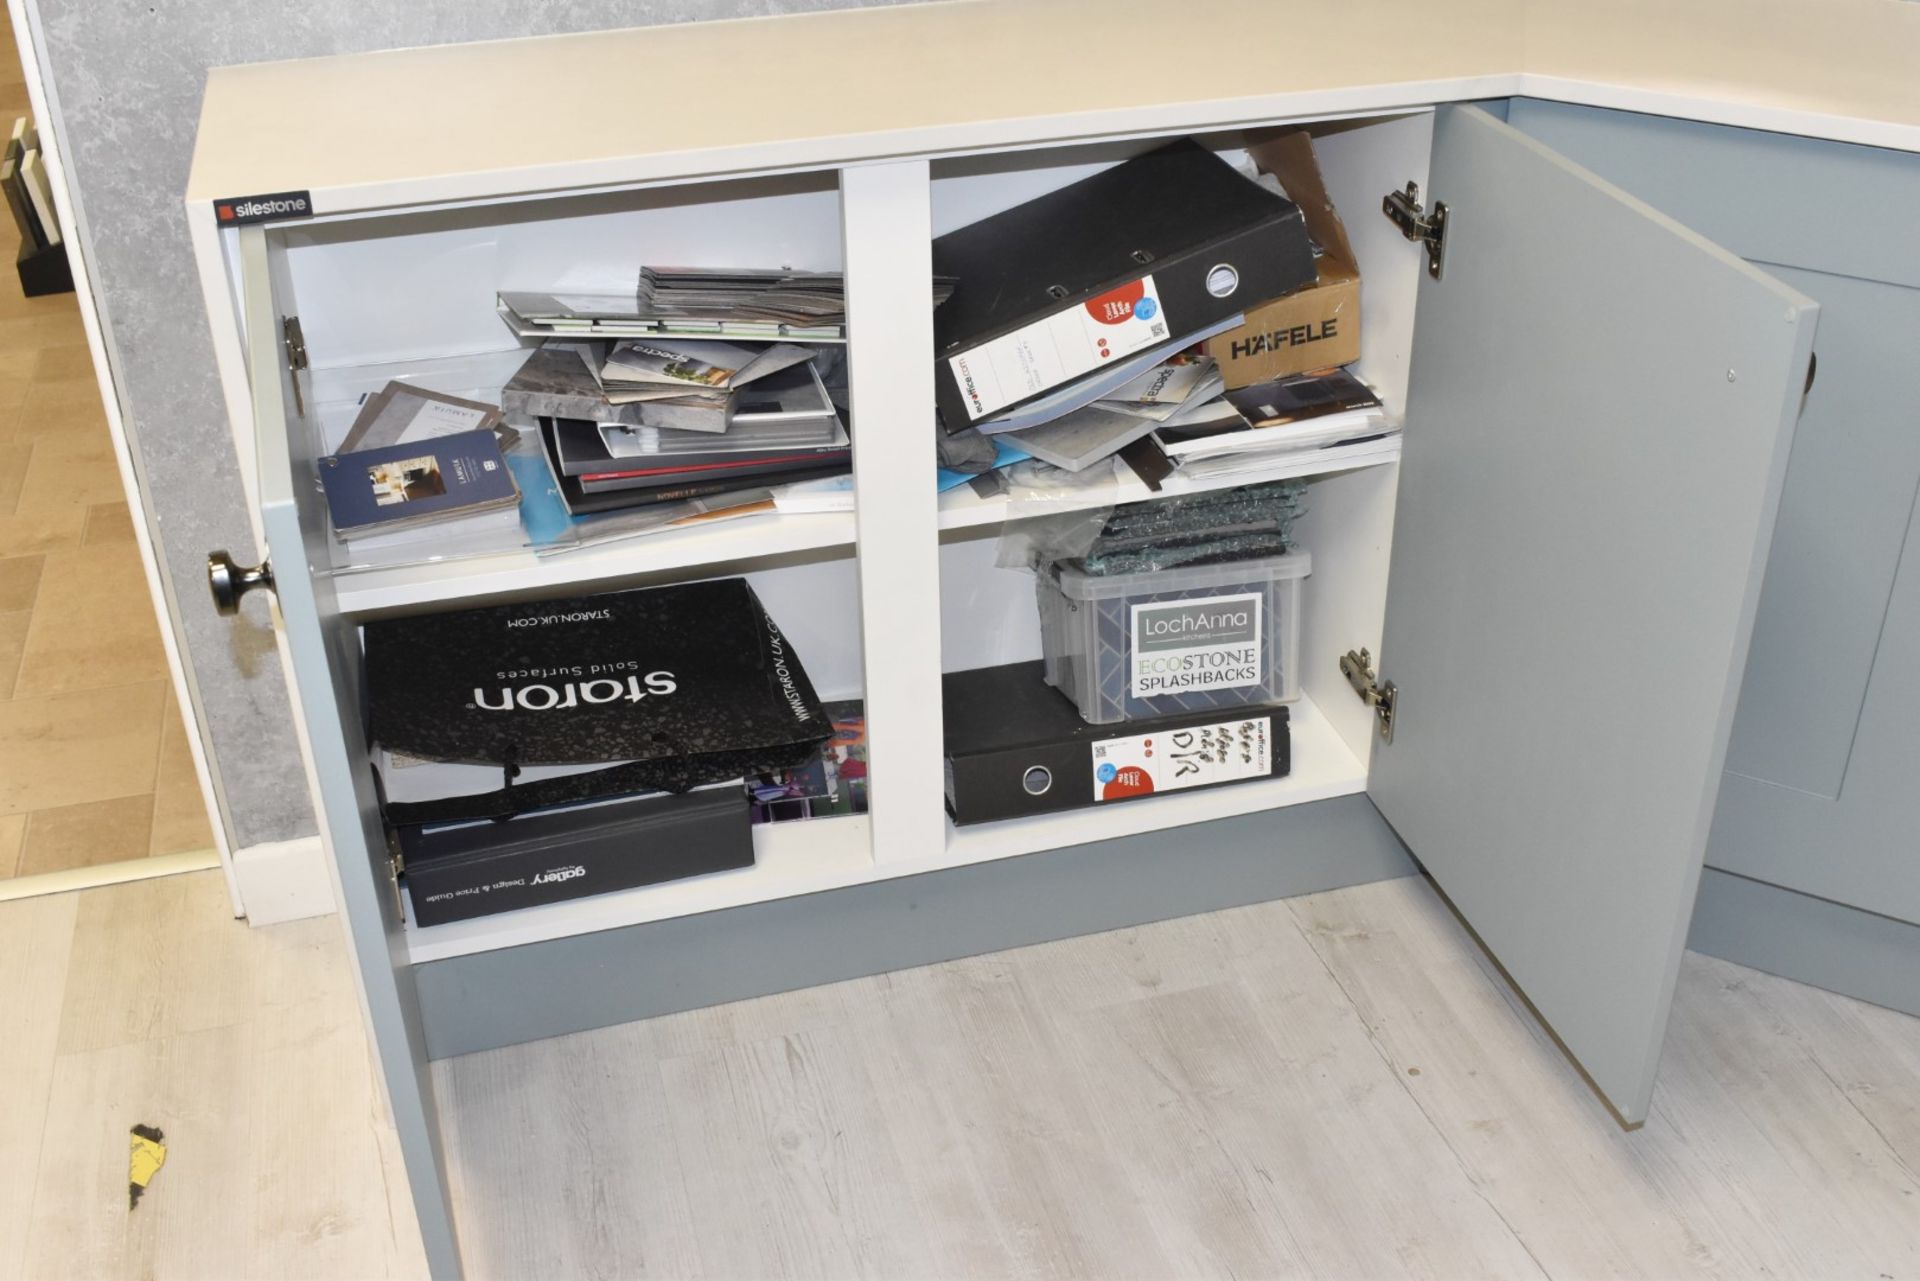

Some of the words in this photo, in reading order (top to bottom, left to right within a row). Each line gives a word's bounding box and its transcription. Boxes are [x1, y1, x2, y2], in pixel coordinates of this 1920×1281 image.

[235, 198, 306, 217] silestone
[1231, 318, 1338, 360] HÄFELE
[632, 345, 690, 363] spectra
[1147, 368, 1175, 397] spectra
[507, 608, 611, 628] STARON.UK.COM
[1145, 611, 1248, 636] LochAnna
[590, 660, 639, 675] Solid
[1138, 648, 1256, 675] ECOSTONE
[496, 665, 583, 680] Surfaces
[1139, 666, 1257, 692] SPLASHBACKS
[473, 670, 678, 711] staron
[492, 878, 525, 890] Design
[532, 865, 586, 886] gallery
[426, 892, 454, 902] Guide
[455, 887, 480, 896] Price
[482, 884, 490, 892] &
